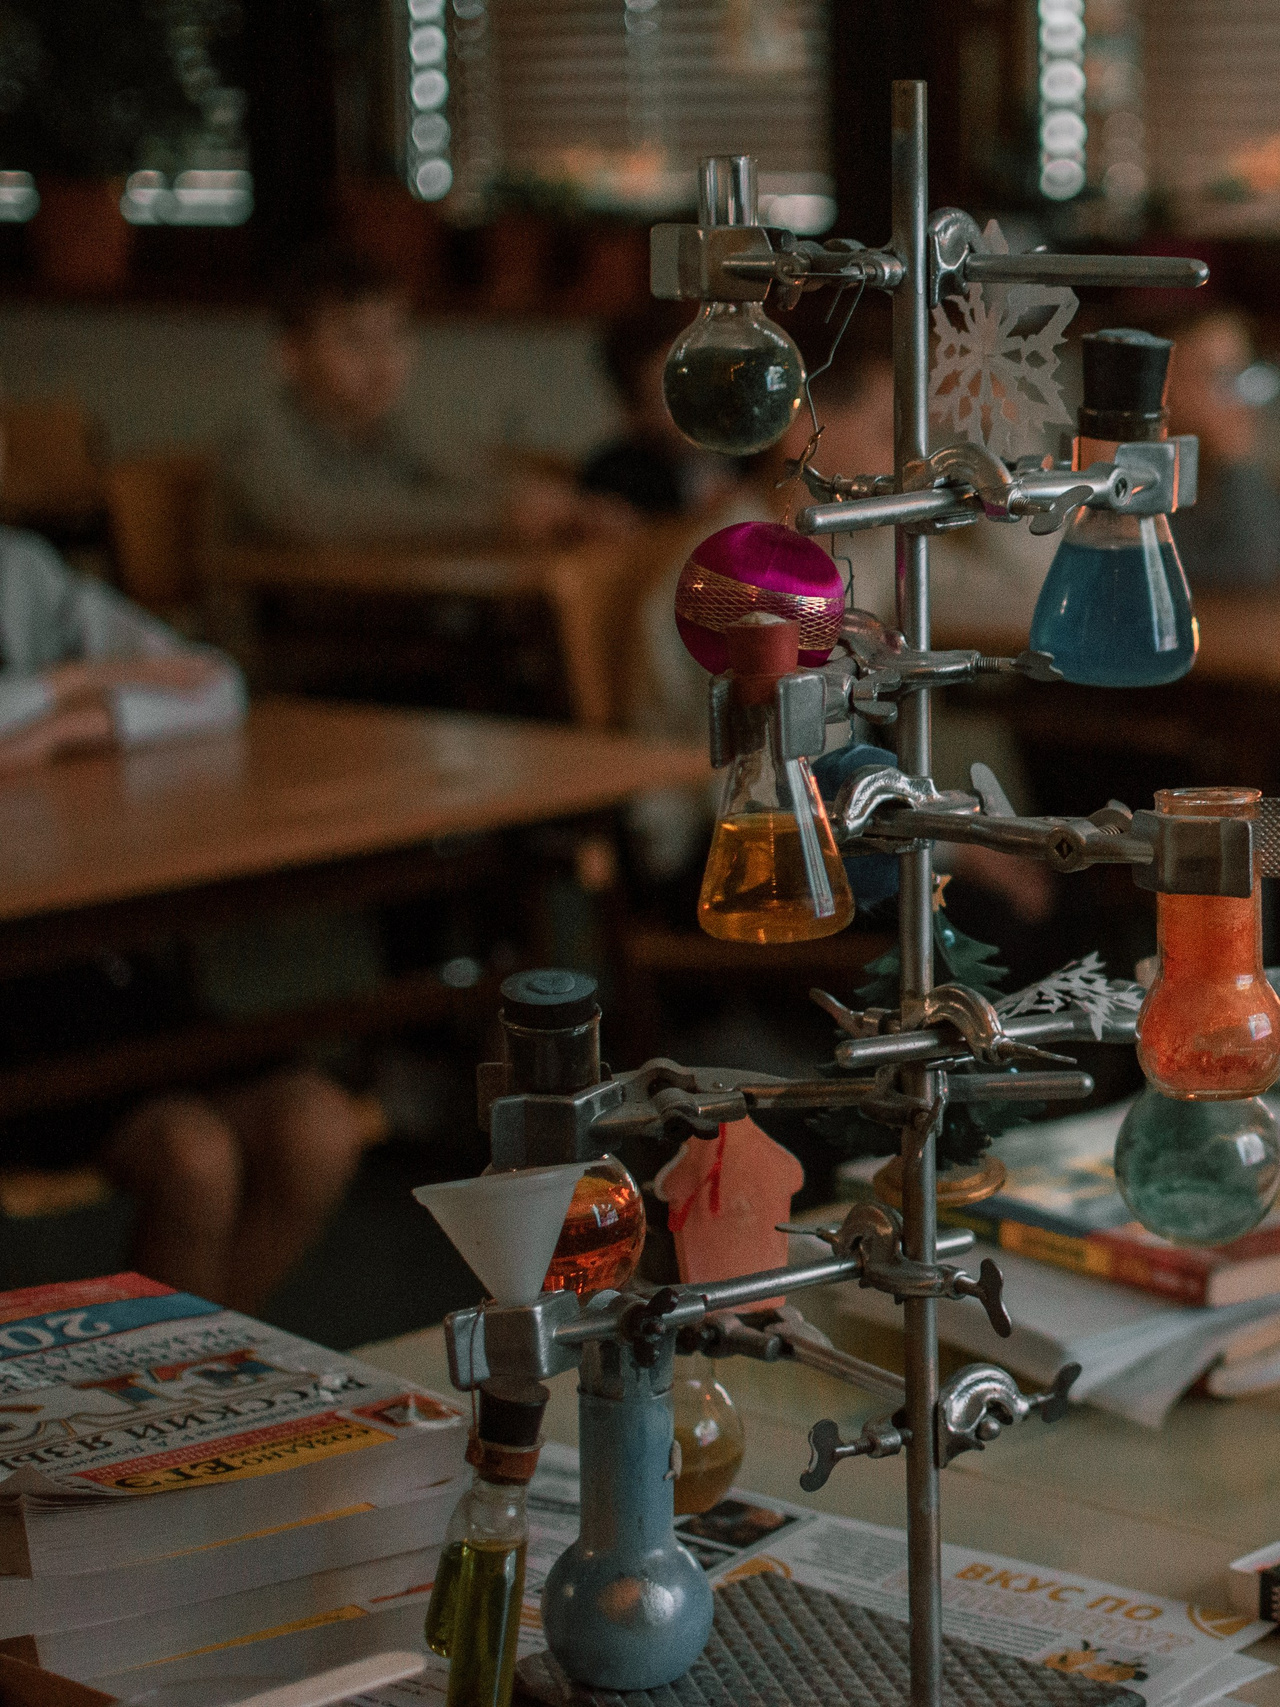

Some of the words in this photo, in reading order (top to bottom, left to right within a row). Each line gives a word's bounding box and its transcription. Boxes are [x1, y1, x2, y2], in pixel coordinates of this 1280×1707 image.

[120, 1375, 368, 1441] РУССКИЙ
[116, 1457, 243, 1488] ЕГЭ
[955, 1562, 1086, 1603] ВКУС
[1086, 1595, 1164, 1621] ПО
